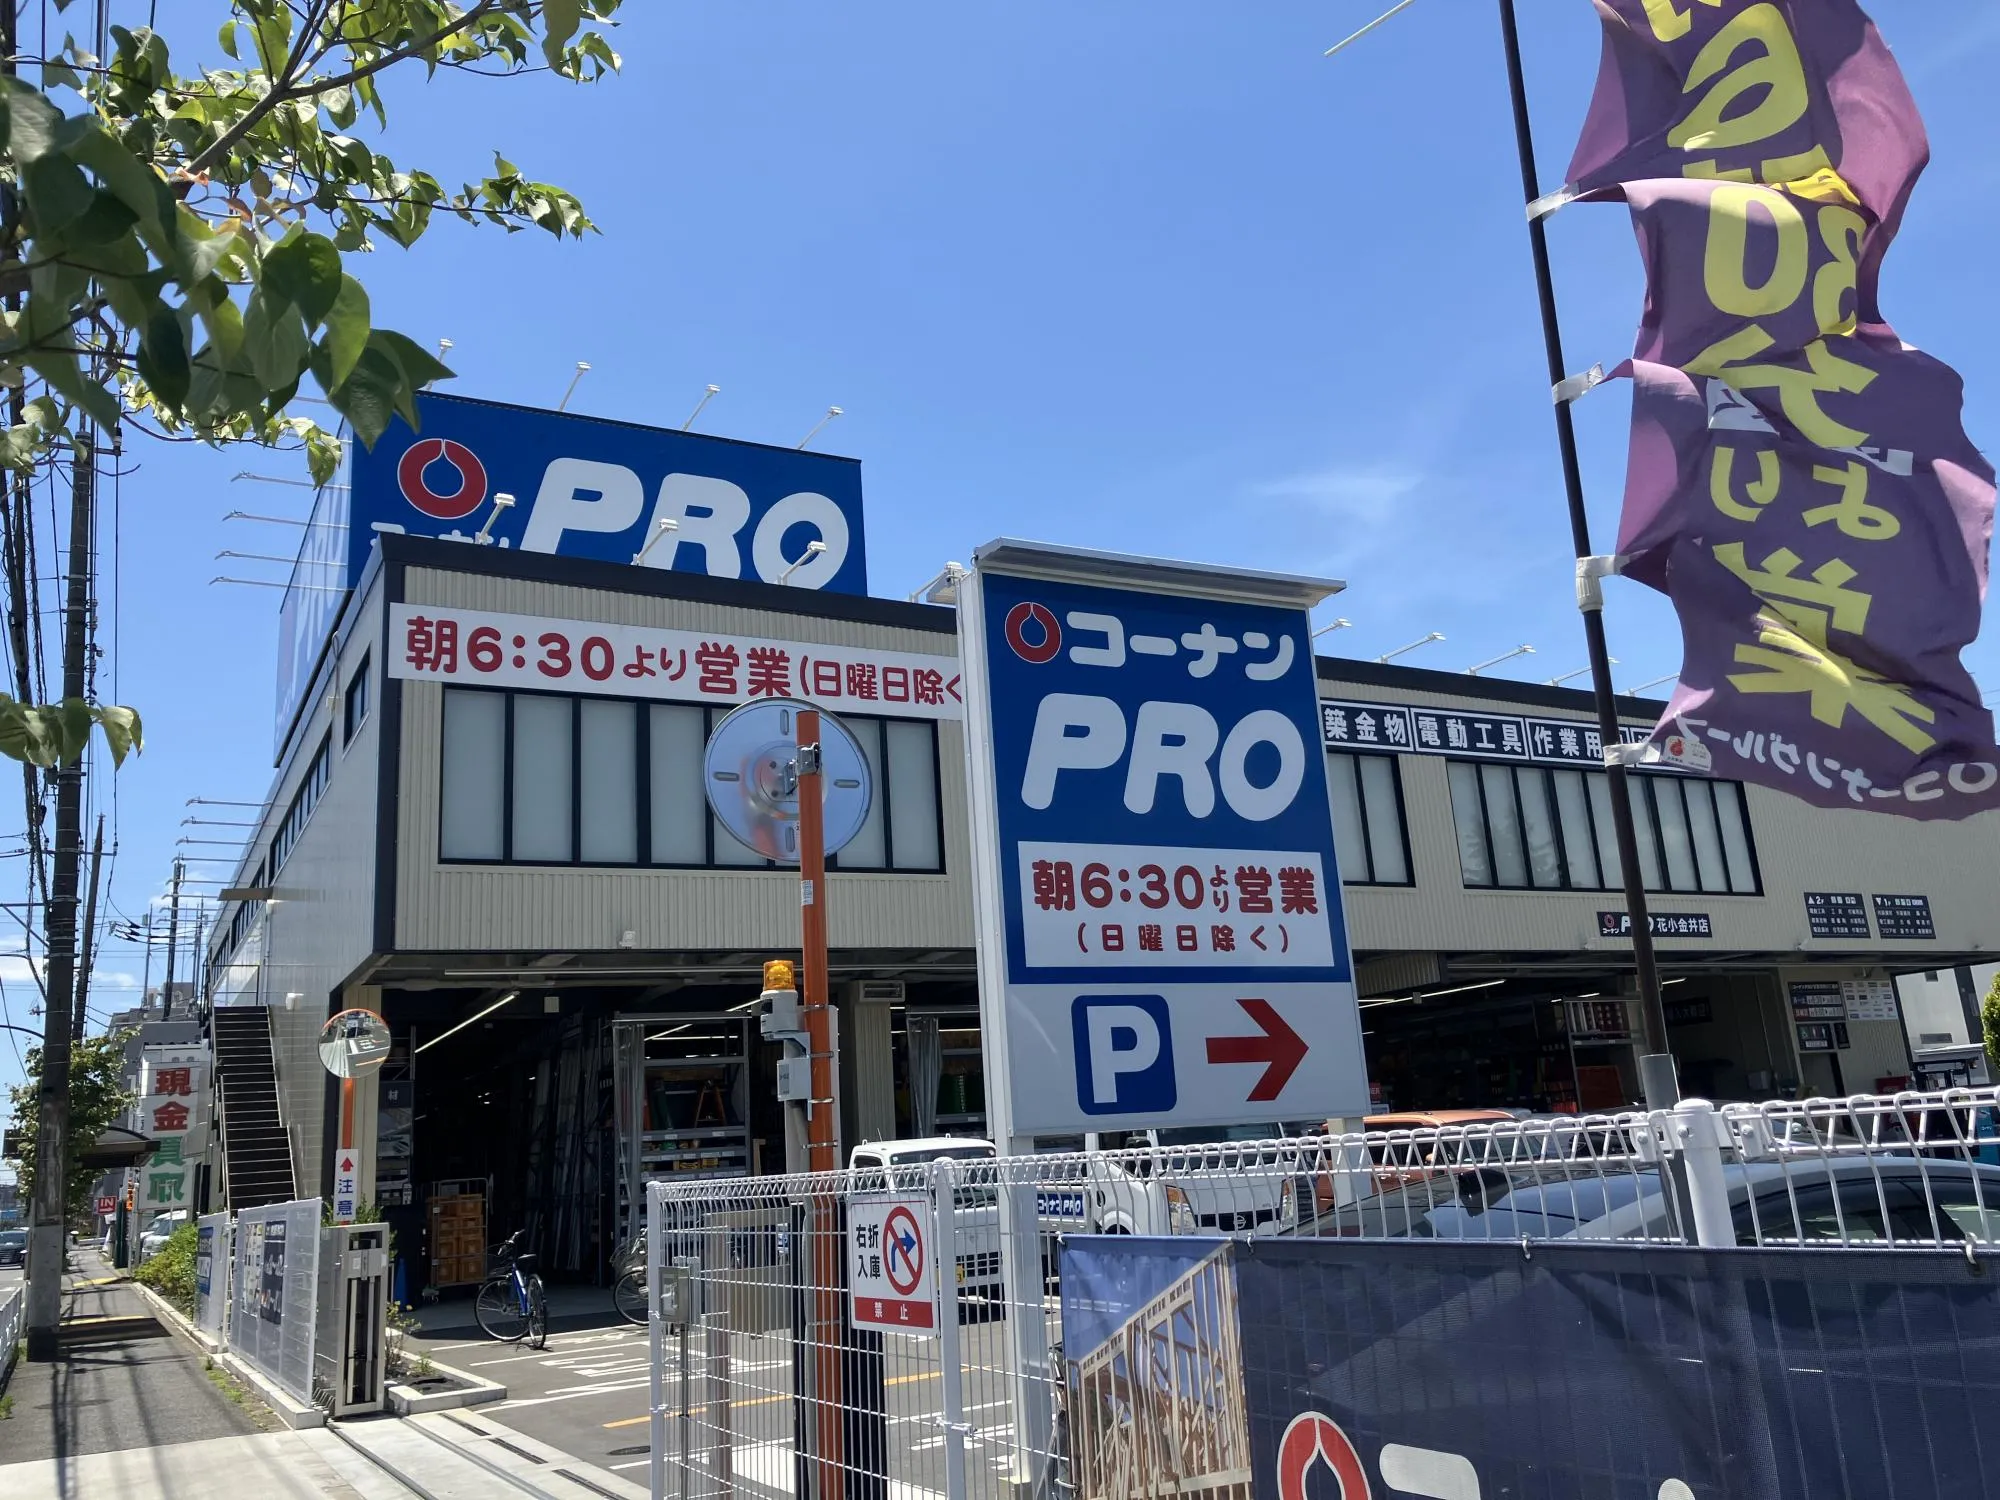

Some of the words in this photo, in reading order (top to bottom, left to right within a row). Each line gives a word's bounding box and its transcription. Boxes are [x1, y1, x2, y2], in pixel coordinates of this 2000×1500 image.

[520, 457, 849, 590] PRO
[1066, 610, 1295, 681] コーナン
[1418, 715, 1523, 752] 電動工具
[1534, 726, 1622, 759] 作業用
[1021, 692, 1306, 822] PRO
[1032, 859, 1319, 915] 朝6:30より営業
[1656, 918, 1709, 933] 花小金井店
[1087, 1005, 1160, 1104] P
[100, 1198, 114, 1208] IN
[337, 1179, 353, 1216] 注意
[856, 1224, 879, 1248] 右折
[857, 1255, 881, 1279] 入庫
[874, 1301, 908, 1320] 禁止
